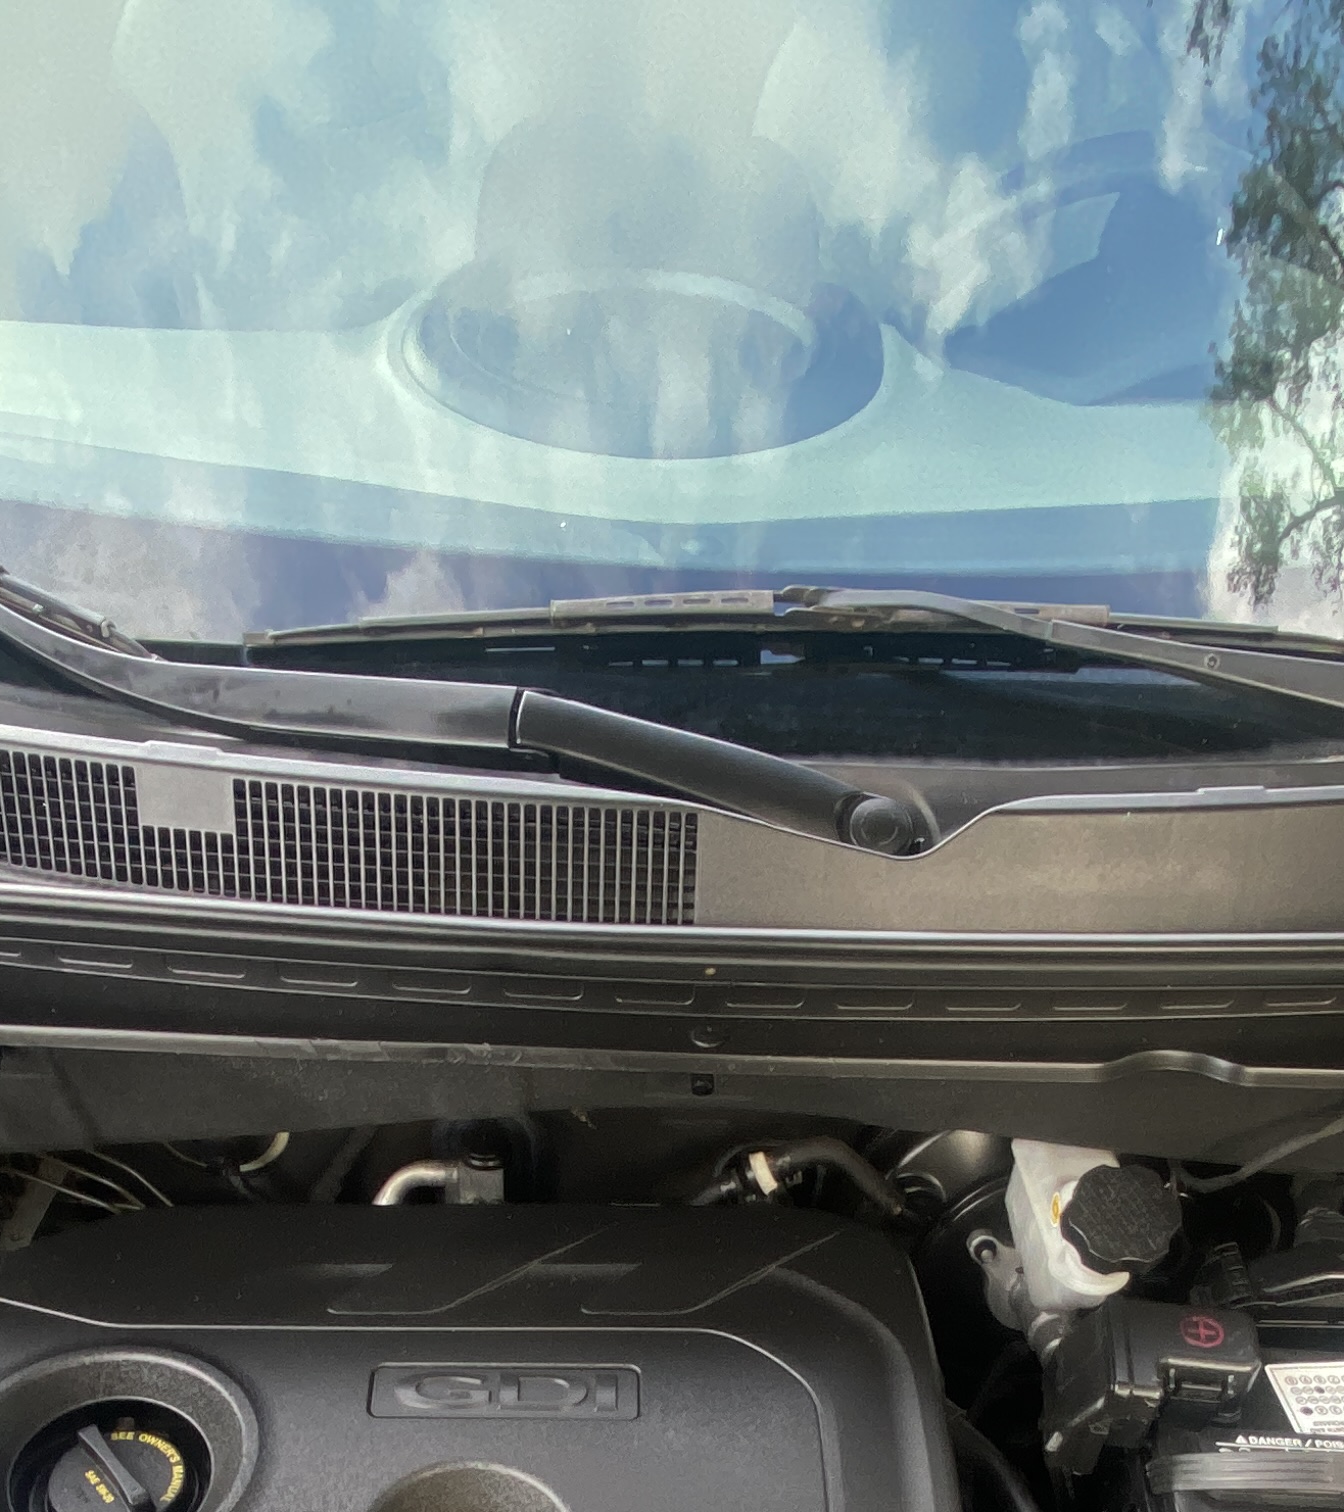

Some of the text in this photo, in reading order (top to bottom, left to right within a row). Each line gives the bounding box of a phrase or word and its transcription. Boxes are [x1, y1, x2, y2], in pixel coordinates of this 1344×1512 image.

[395, 1373, 619, 1411] GDI
[1248, 1436, 1302, 1447] DANGER
[1305, 1438, 1313, 1448] /
[84, 1469, 101, 1486] SAE
[111, 1431, 185, 1502] SEE OWNER'S MANUAL
